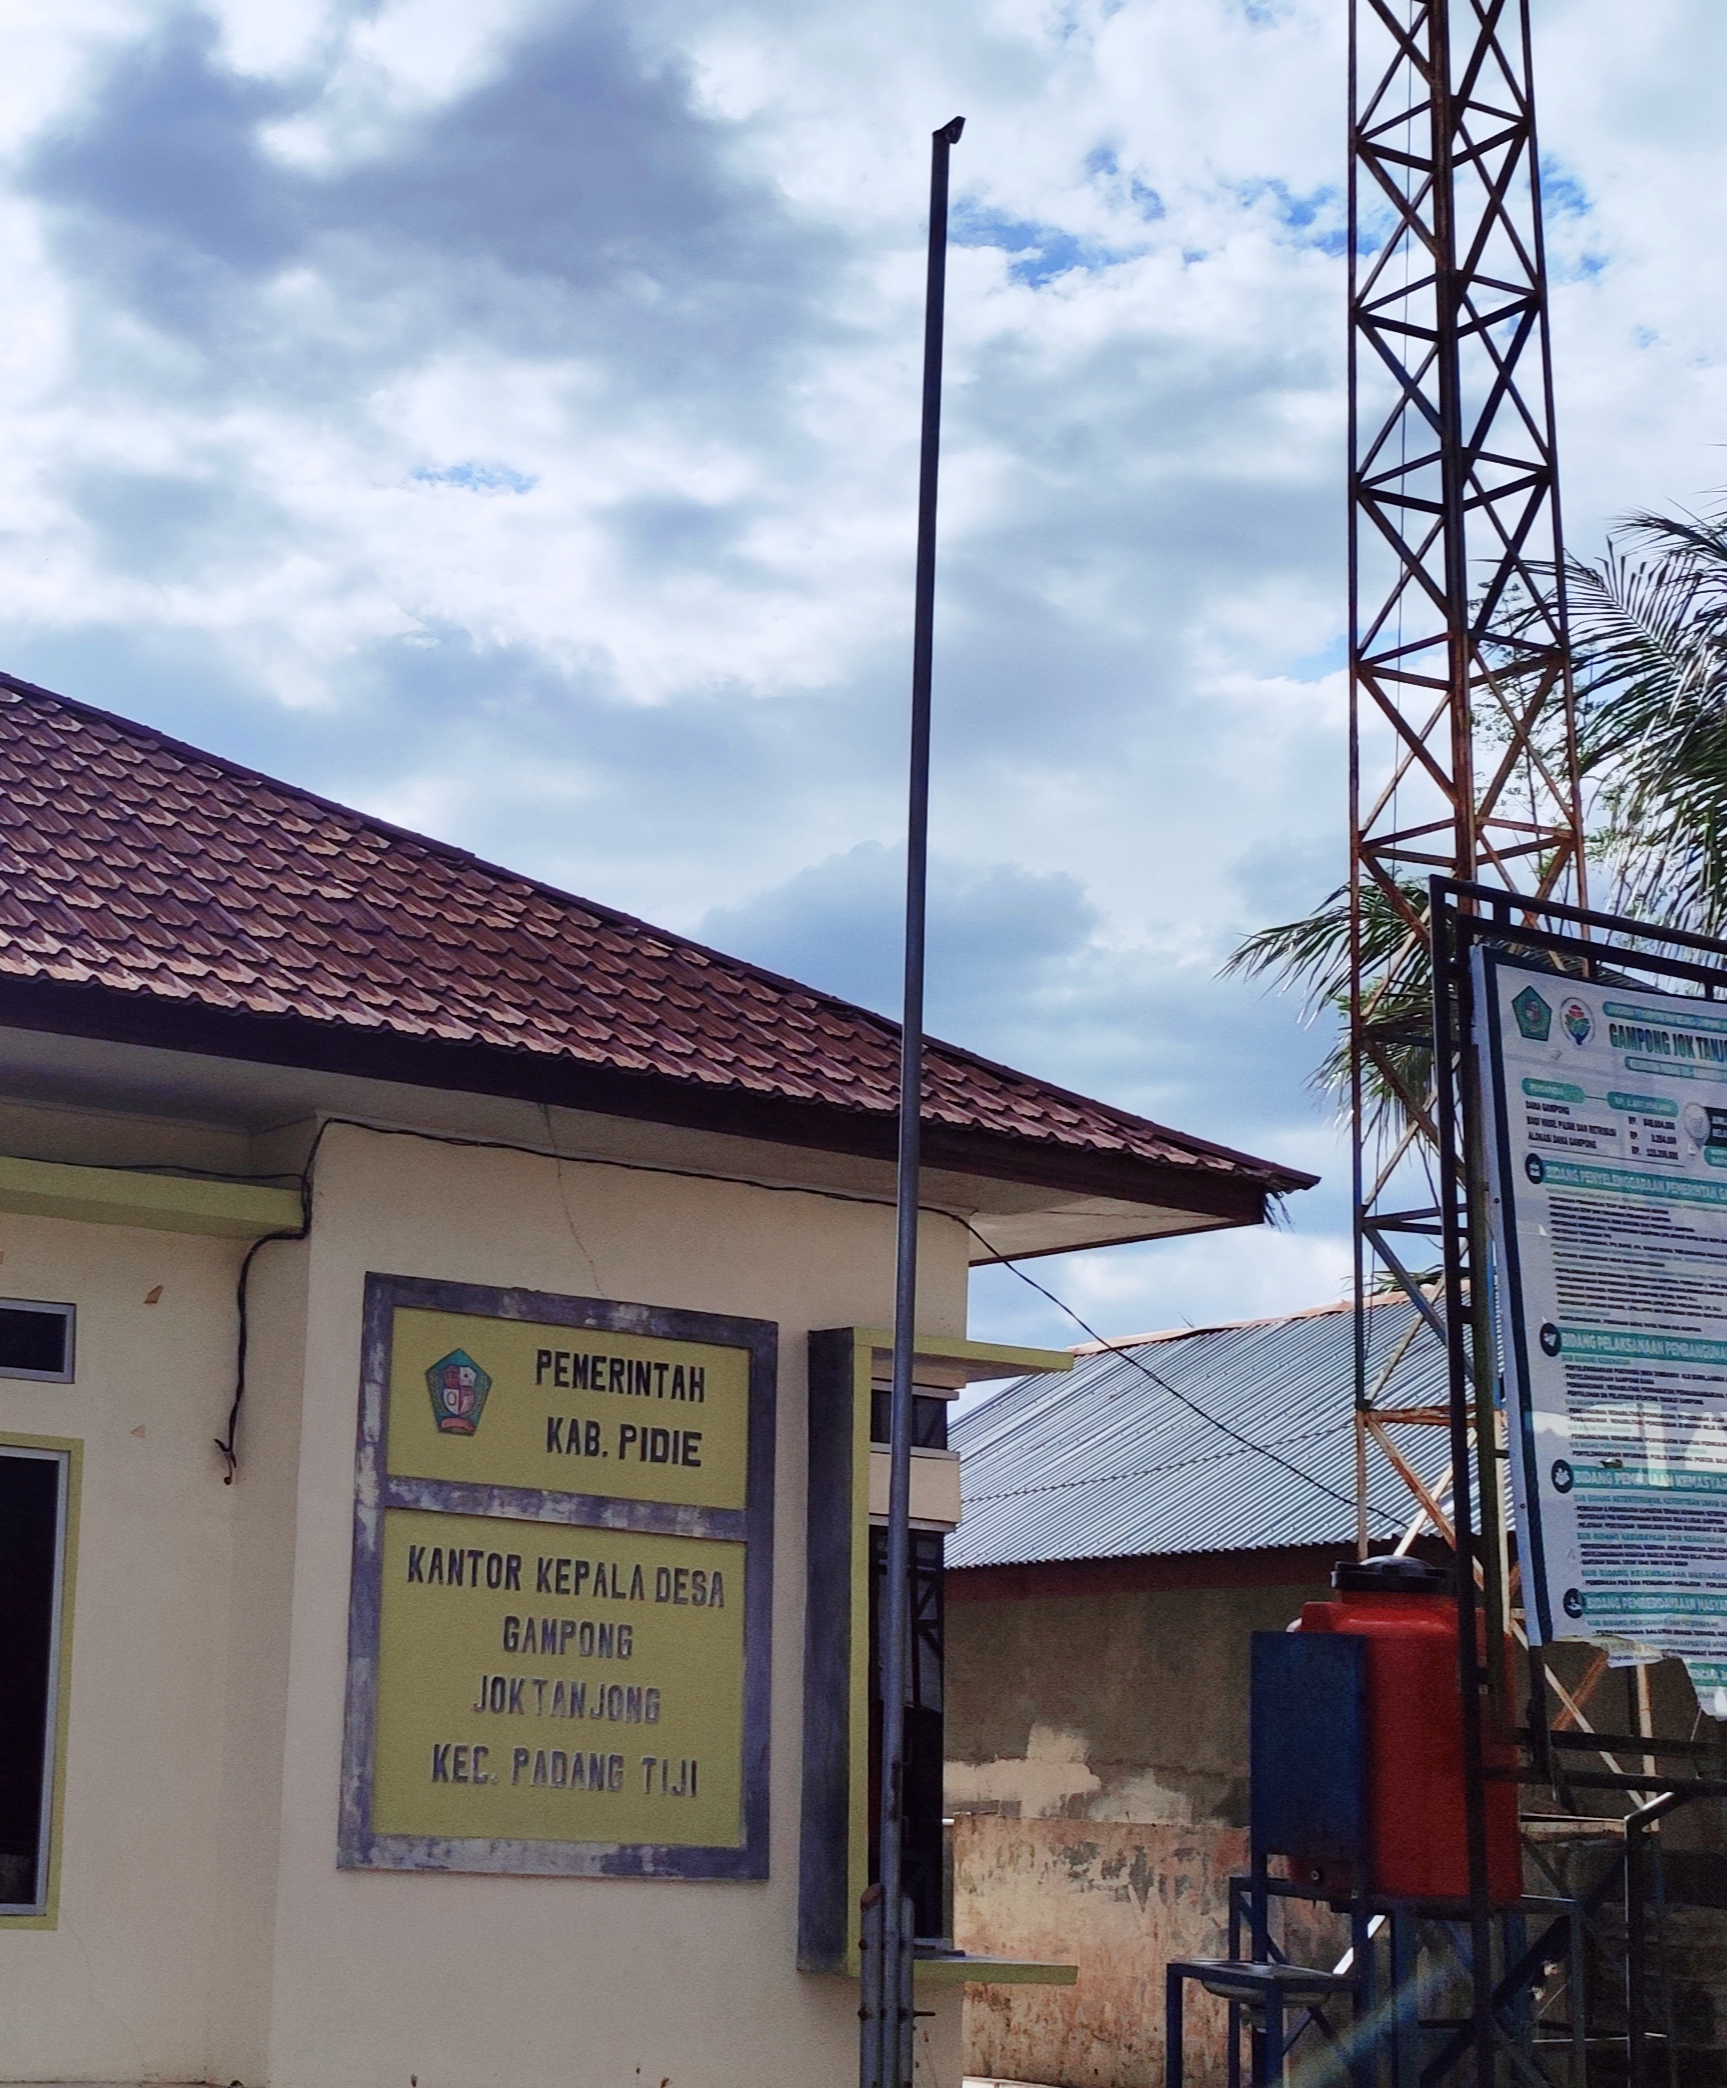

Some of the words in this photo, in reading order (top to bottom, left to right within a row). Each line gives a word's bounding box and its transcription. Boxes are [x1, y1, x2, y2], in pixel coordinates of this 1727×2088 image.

[1609, 1023, 1670, 1055] GAMPONG
[535, 1349, 705, 1403] PEMERINTAH
[546, 1416, 609, 1458] KAB.
[618, 1423, 702, 1467] PIDIE
[407, 1545, 522, 1591] KANTOR
[536, 1557, 645, 1601] KEPALA
[655, 1566, 725, 1607] DESA
[503, 1615, 634, 1659] GAMPONG
[473, 1675, 525, 1715] JOK
[532, 1678, 660, 1724] TANJONG
[432, 1744, 498, 1785] KEC.
[512, 1747, 624, 1792] PADANG
[641, 1756, 697, 1797] TIJI
